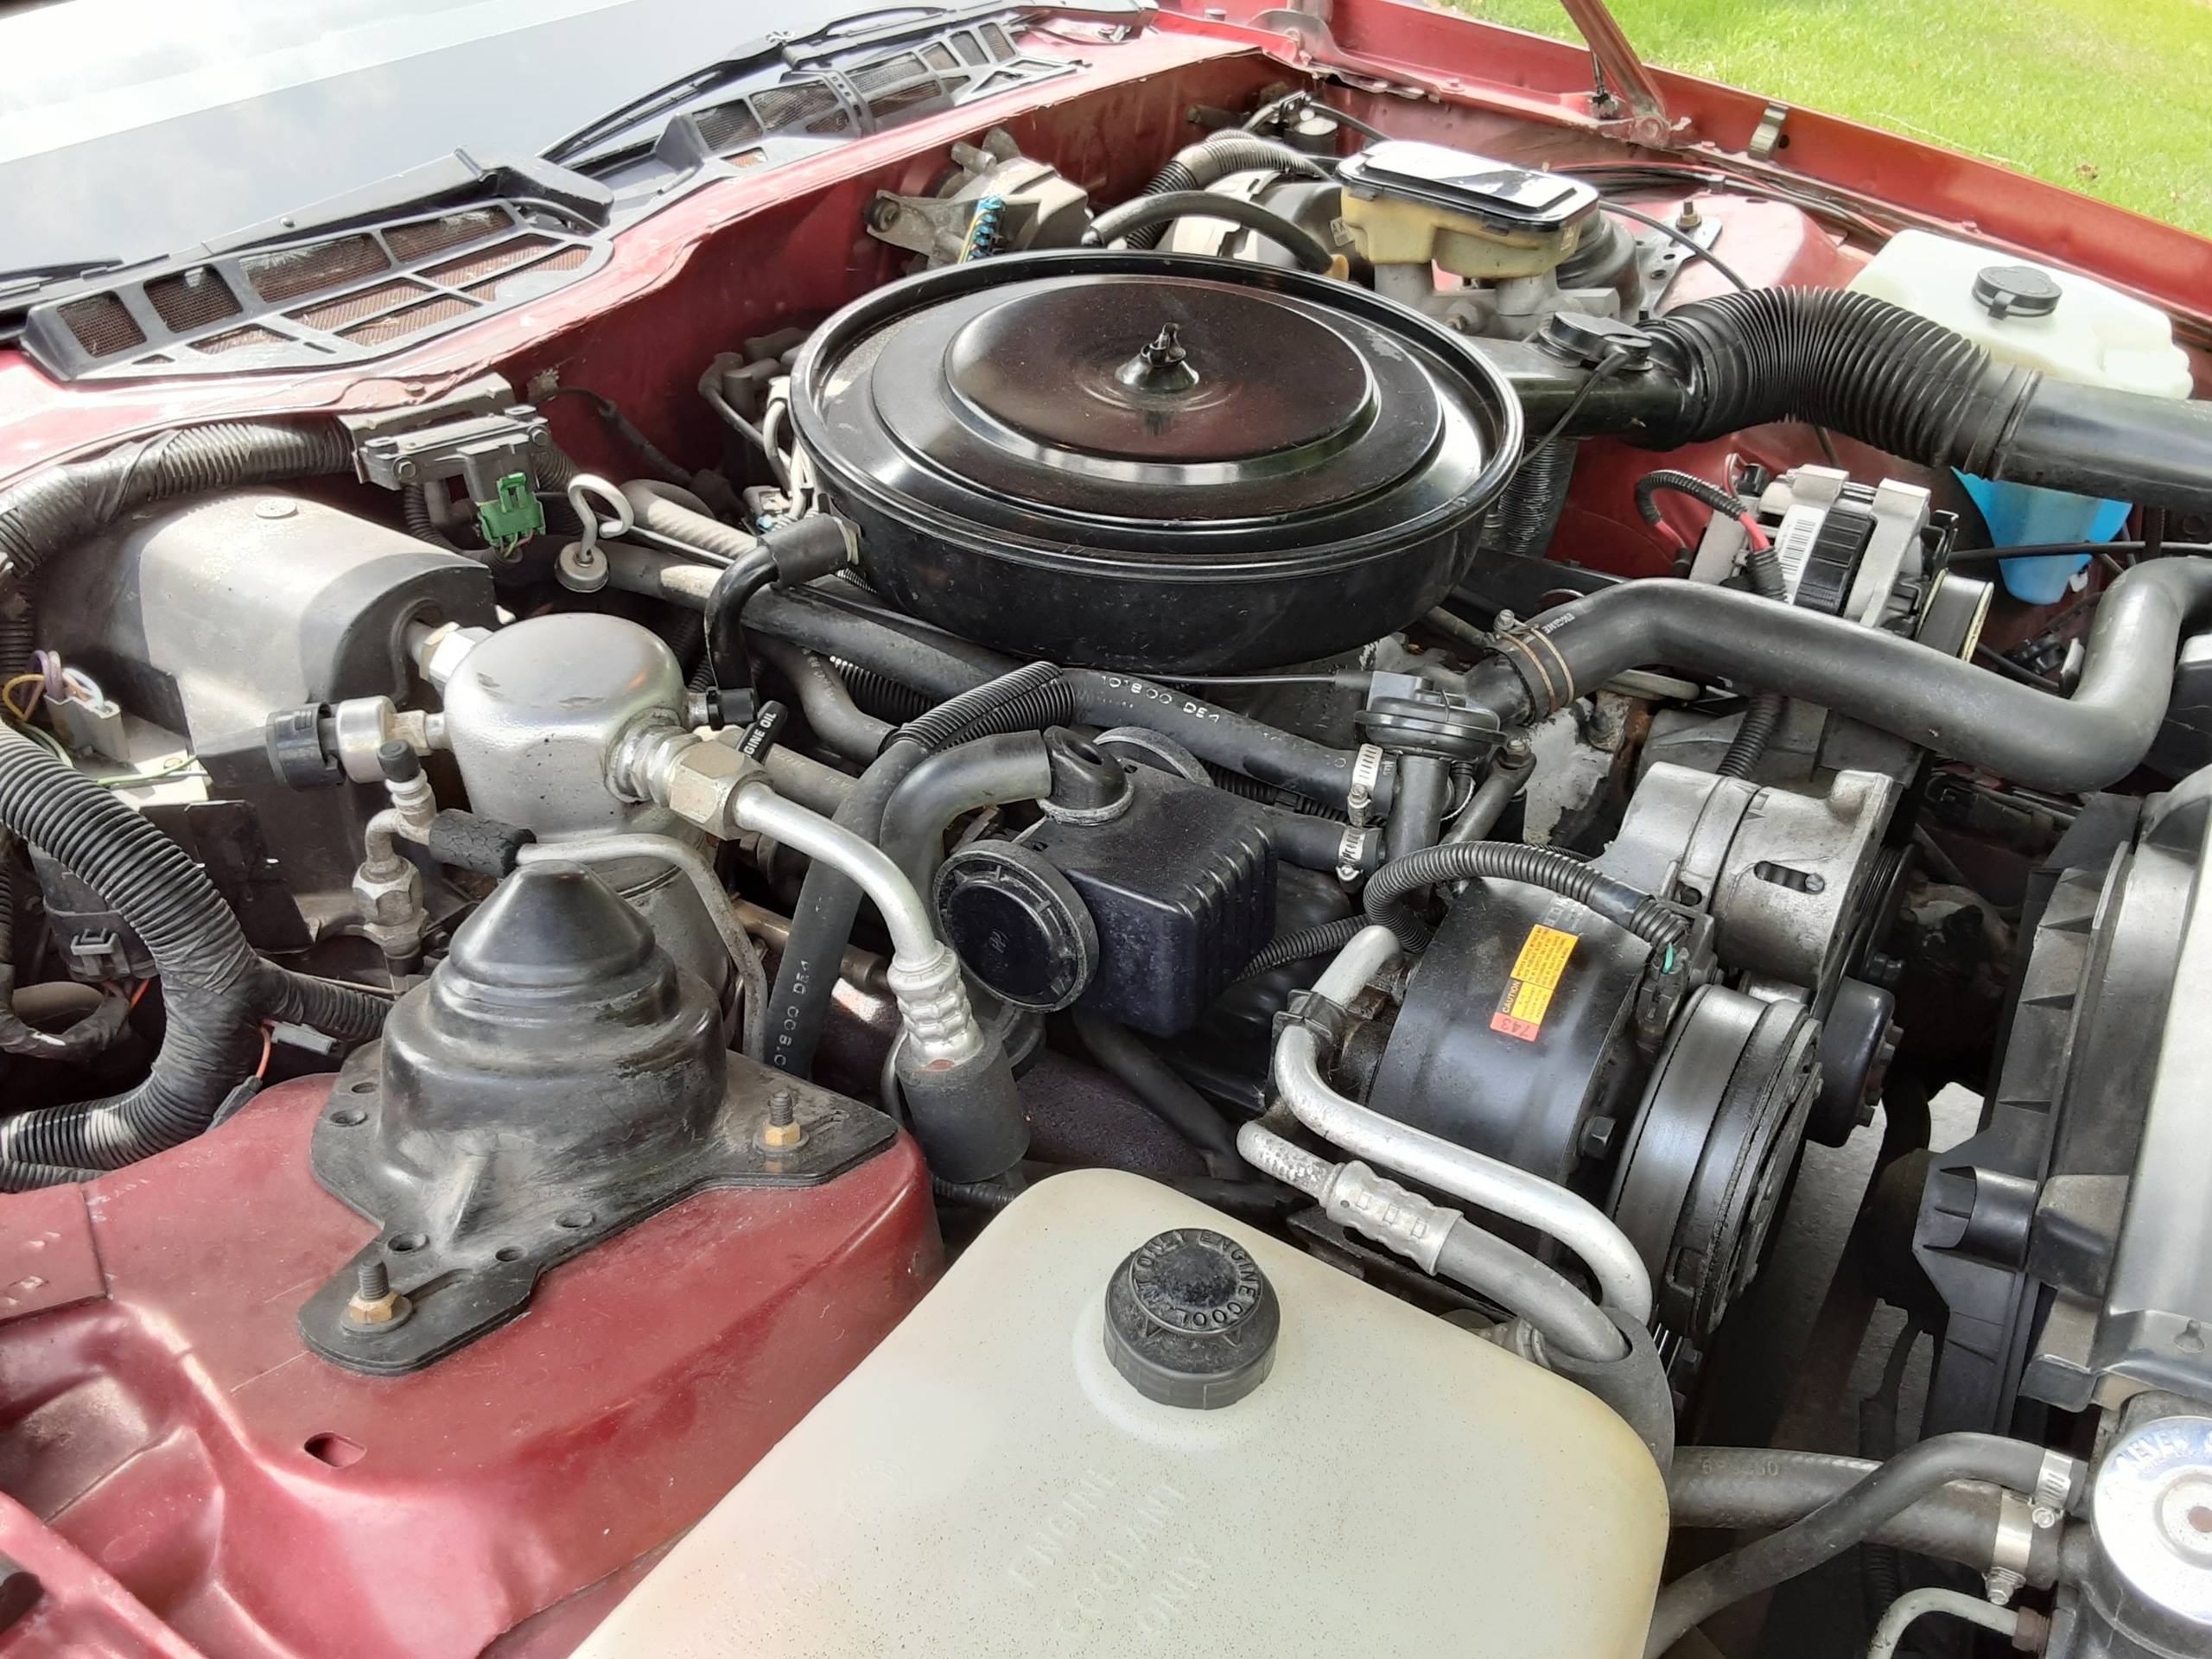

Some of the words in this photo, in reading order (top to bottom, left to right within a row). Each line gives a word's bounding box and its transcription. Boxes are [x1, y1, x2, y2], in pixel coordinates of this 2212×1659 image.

[744, 728, 766, 758] GINE
[760, 713, 777, 728] OIL
[1502, 981, 1522, 1014] CAUTION
[1502, 1018, 1530, 1037] 743
[1198, 1230, 1261, 1298] ENGINE
